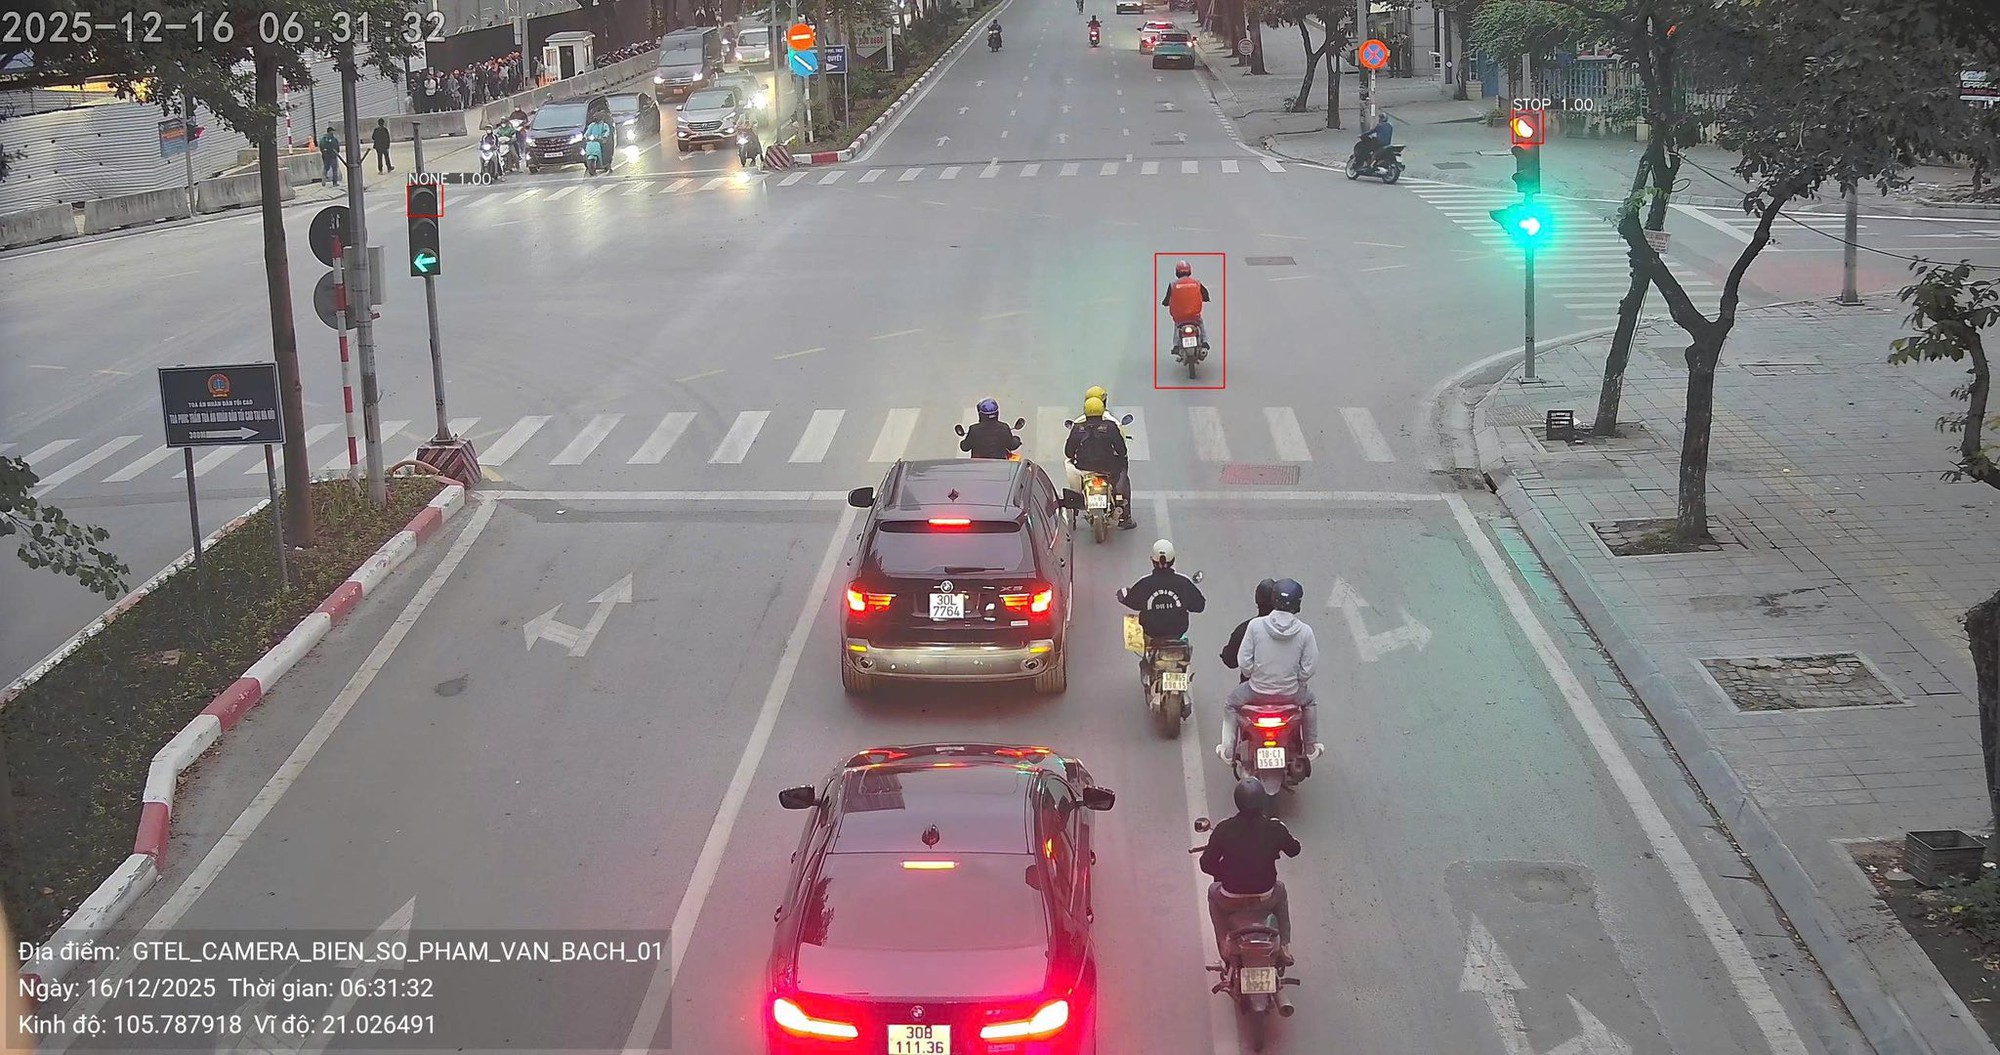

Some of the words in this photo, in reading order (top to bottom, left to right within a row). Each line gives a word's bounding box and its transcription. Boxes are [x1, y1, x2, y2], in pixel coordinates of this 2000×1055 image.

[936, 595, 957, 606] 30L
[932, 605, 960, 617] 7764
[906, 1026, 933, 1039] 30B
[896, 1041, 944, 1053] 111.36
